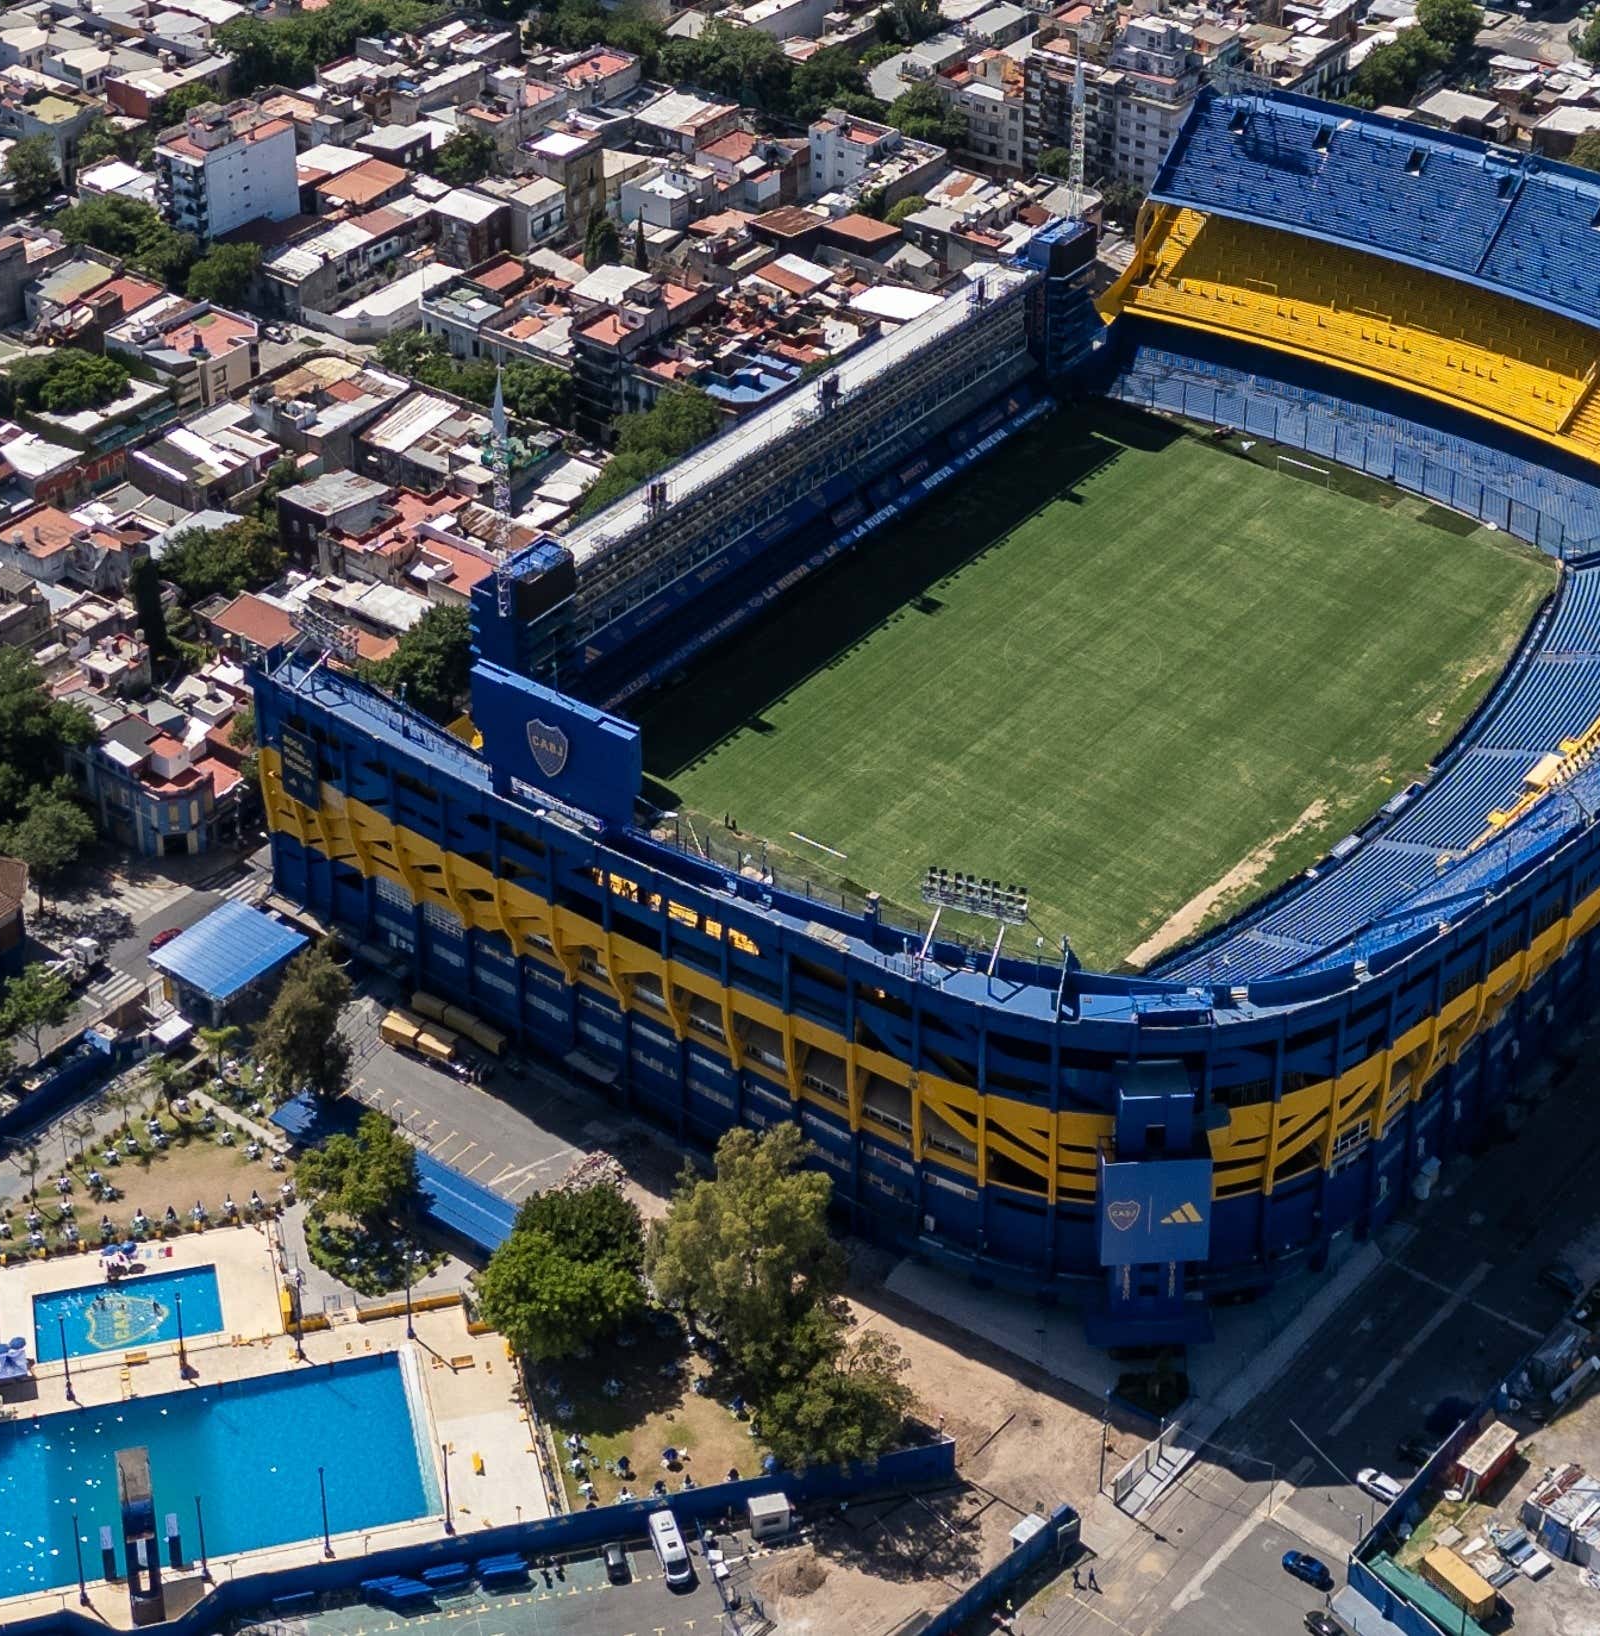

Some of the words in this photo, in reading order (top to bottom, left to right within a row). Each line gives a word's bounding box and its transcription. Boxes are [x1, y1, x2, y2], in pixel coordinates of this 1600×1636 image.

[976, 428, 1009, 452] NUEVA
[921, 465, 956, 491] NUEVA
[864, 504, 899, 530] NUEVA
[775, 564, 811, 590] NUEVA
[531, 735, 564, 757] CABJ
